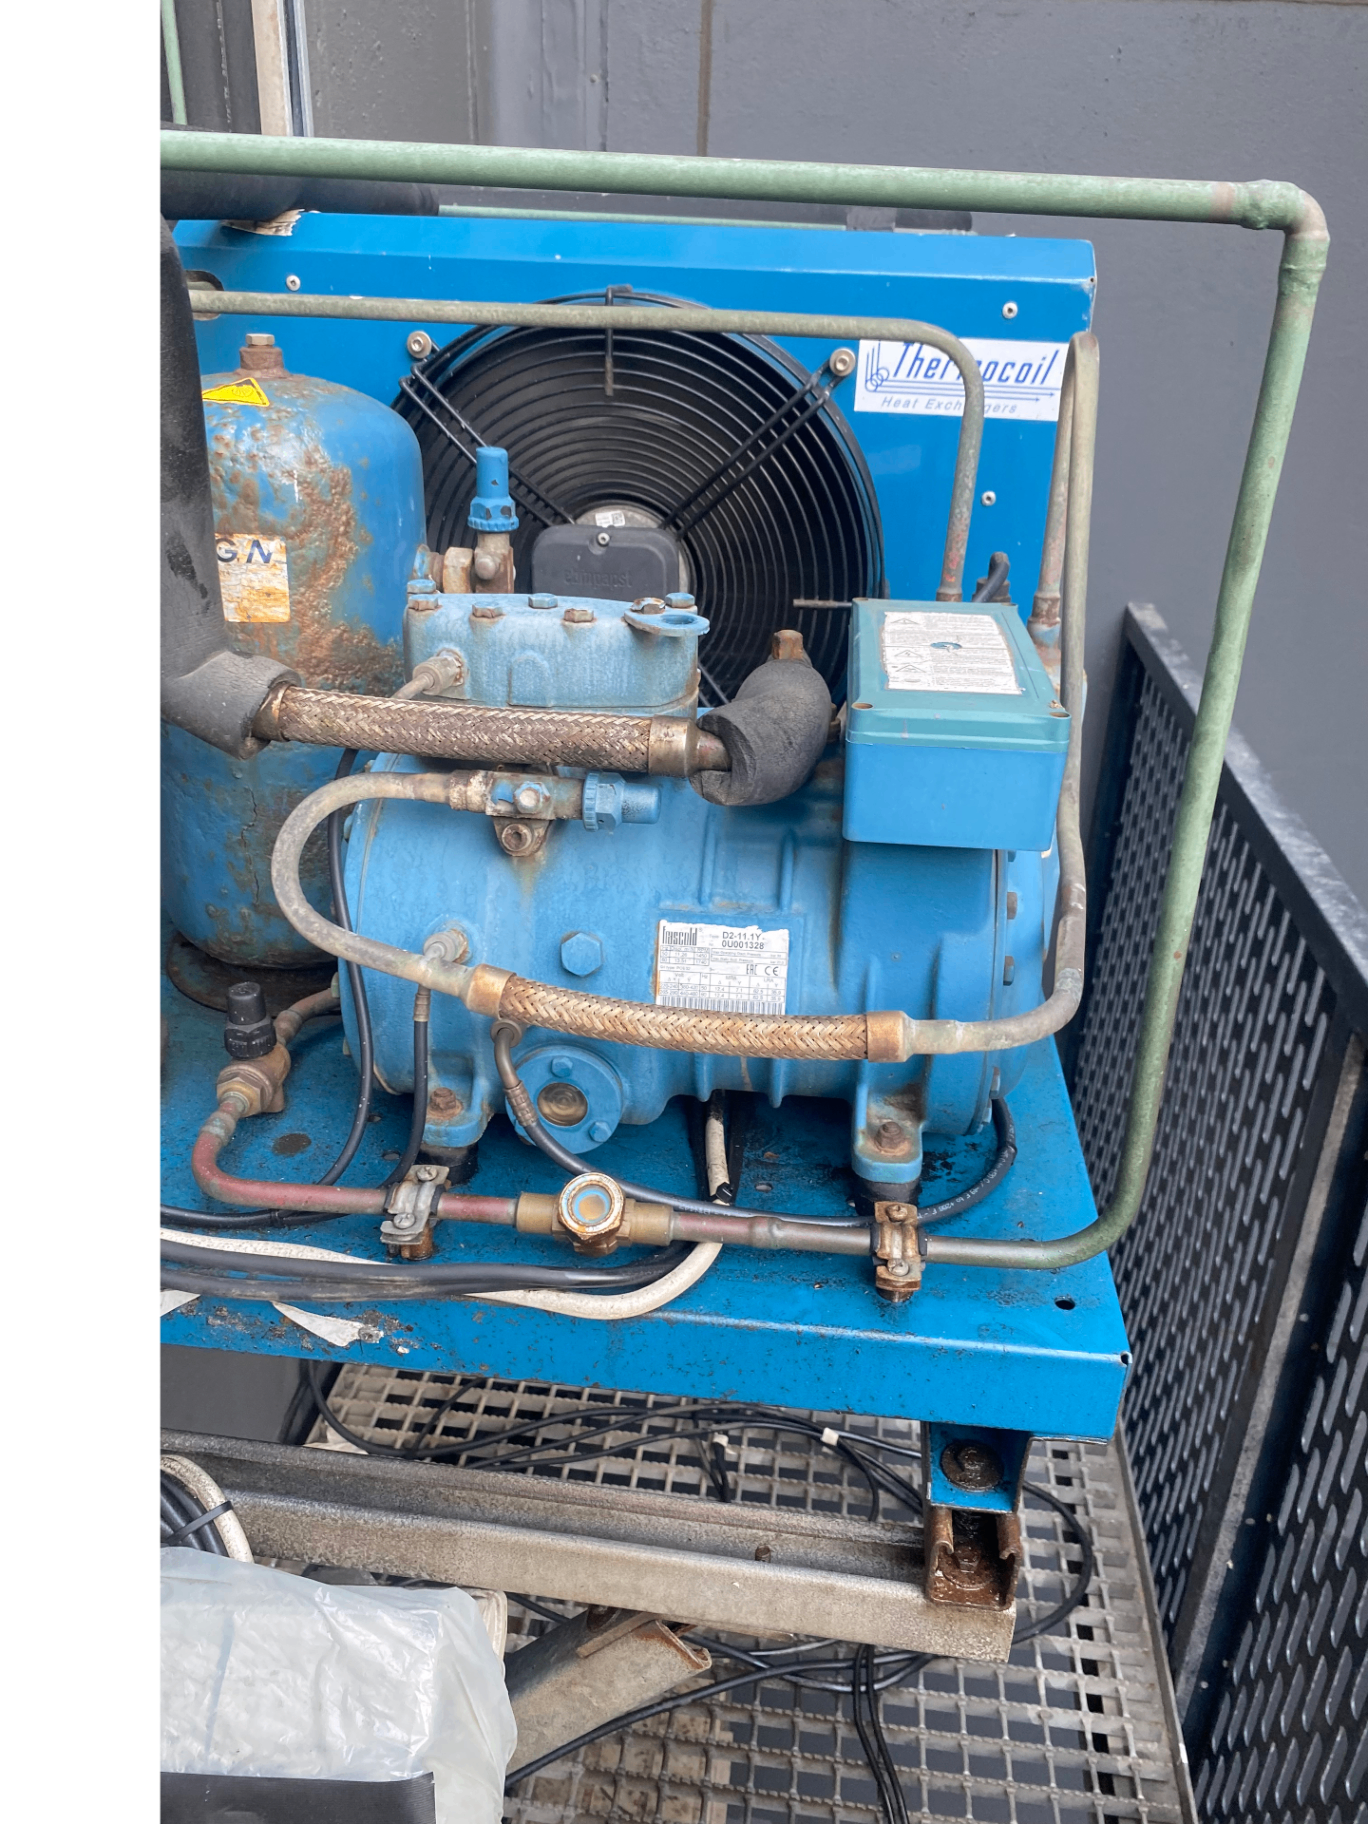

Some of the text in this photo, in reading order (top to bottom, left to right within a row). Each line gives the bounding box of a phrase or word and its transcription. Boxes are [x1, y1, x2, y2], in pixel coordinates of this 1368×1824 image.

[893, 342, 1060, 385] Therocoil
[880, 396, 1019, 415] Heat Exchgers
